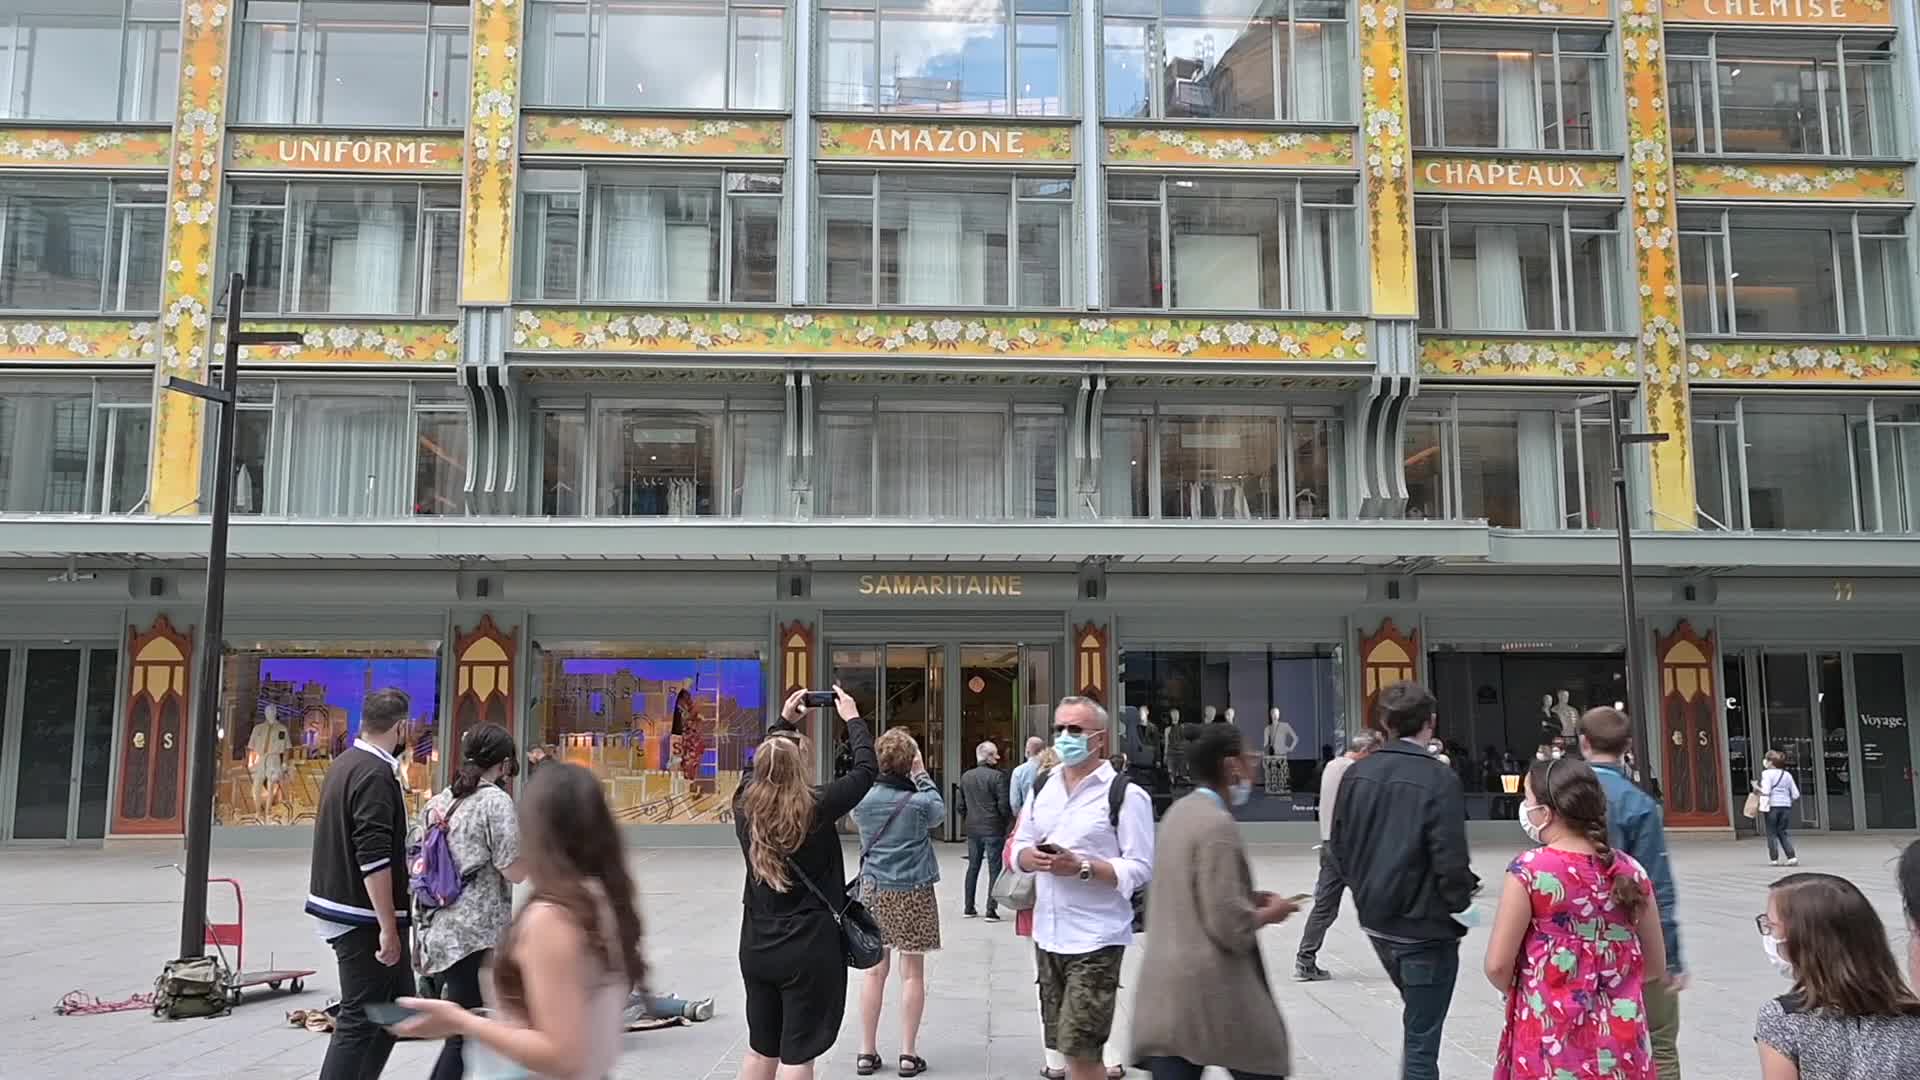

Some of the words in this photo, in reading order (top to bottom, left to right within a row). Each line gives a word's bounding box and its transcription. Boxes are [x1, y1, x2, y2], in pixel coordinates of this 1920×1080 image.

[1703, 0, 1846, 17] CHEMISE
[279, 140, 437, 165] UNIFORME
[867, 128, 1024, 153] AMAZONE
[1425, 162, 1584, 187] CHAPEAUX
[859, 575, 1022, 596] SAMARITAINE
